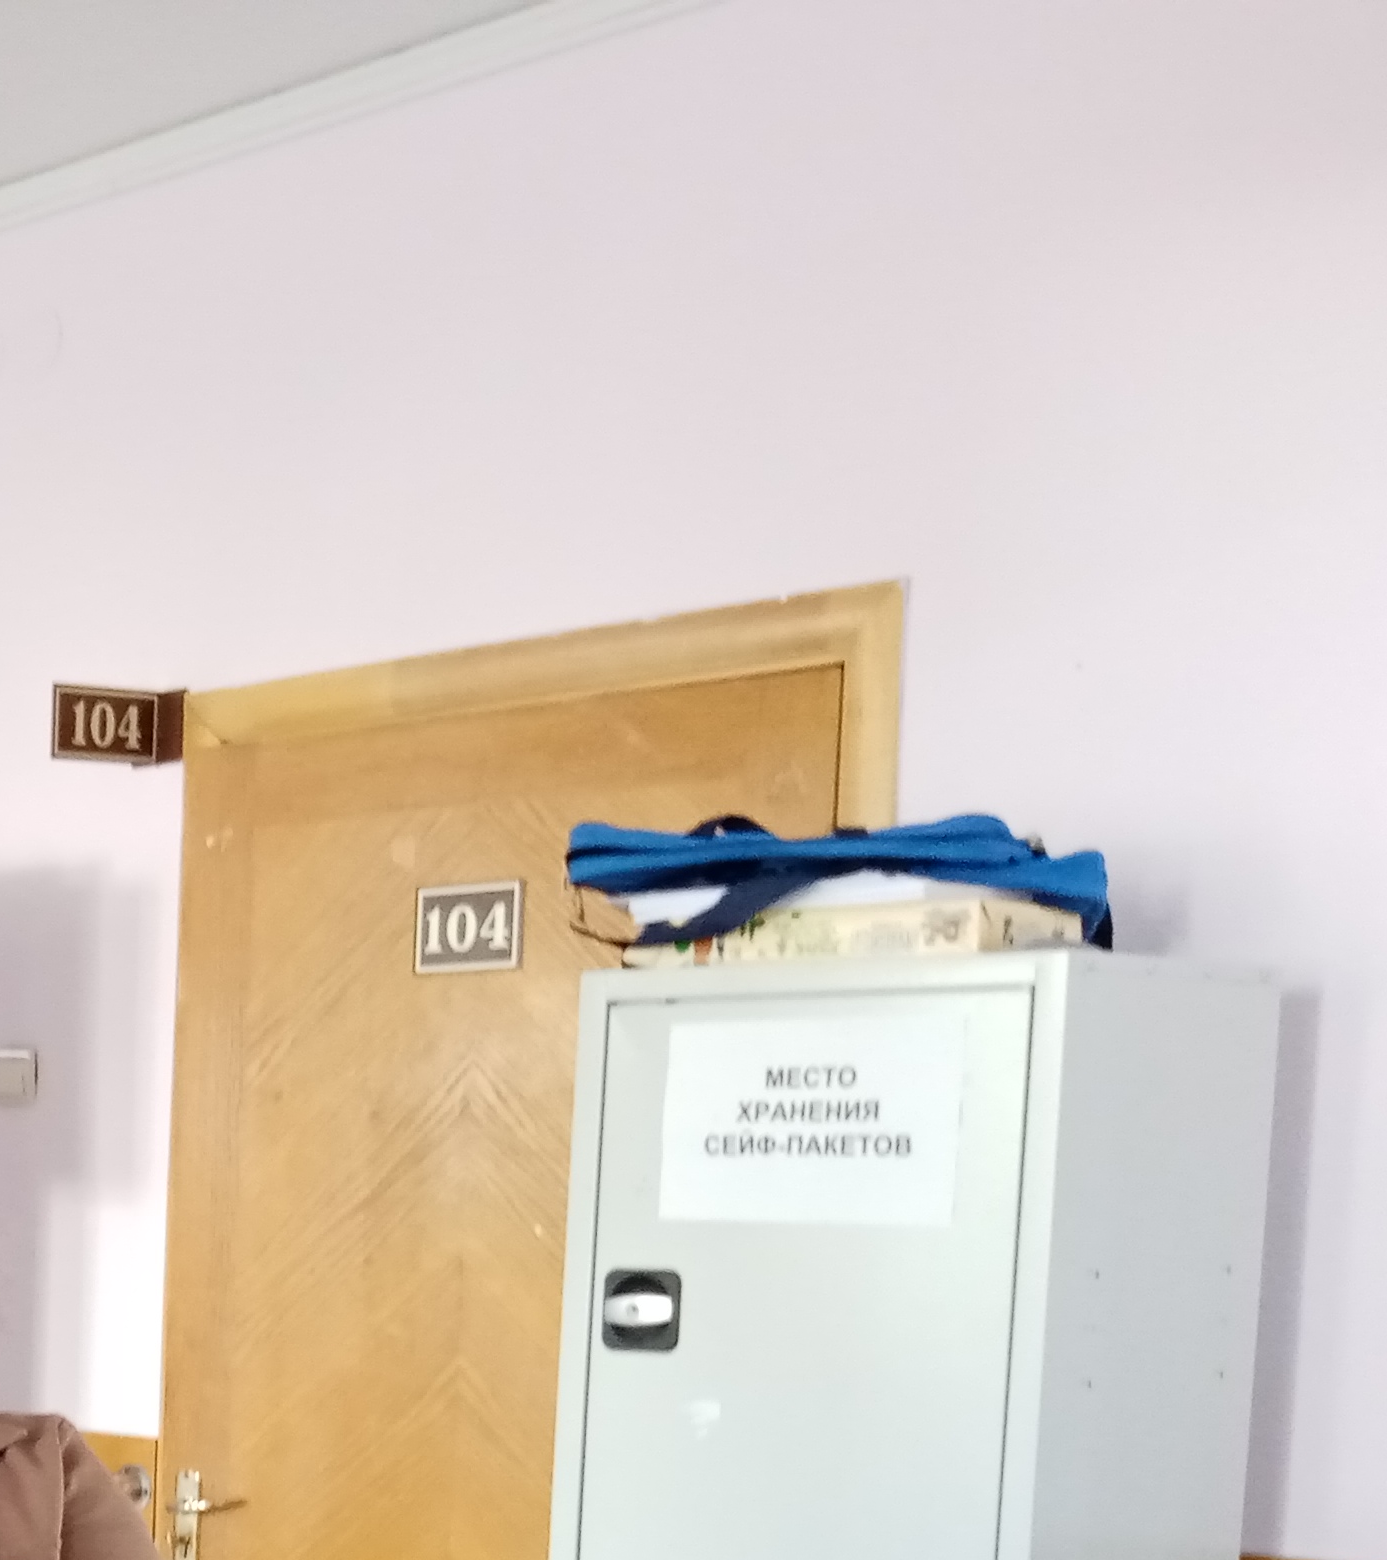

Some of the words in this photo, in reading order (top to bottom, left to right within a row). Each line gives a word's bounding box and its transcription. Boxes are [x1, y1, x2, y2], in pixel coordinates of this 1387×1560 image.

[71, 700, 142, 751] 104
[424, 901, 510, 955] 104
[765, 1065, 857, 1090] МЕСТО
[737, 1100, 881, 1123] ХРАНЕНИЯ
[704, 1131, 912, 1157] СЕЙФ-ПАКЕТОВ
